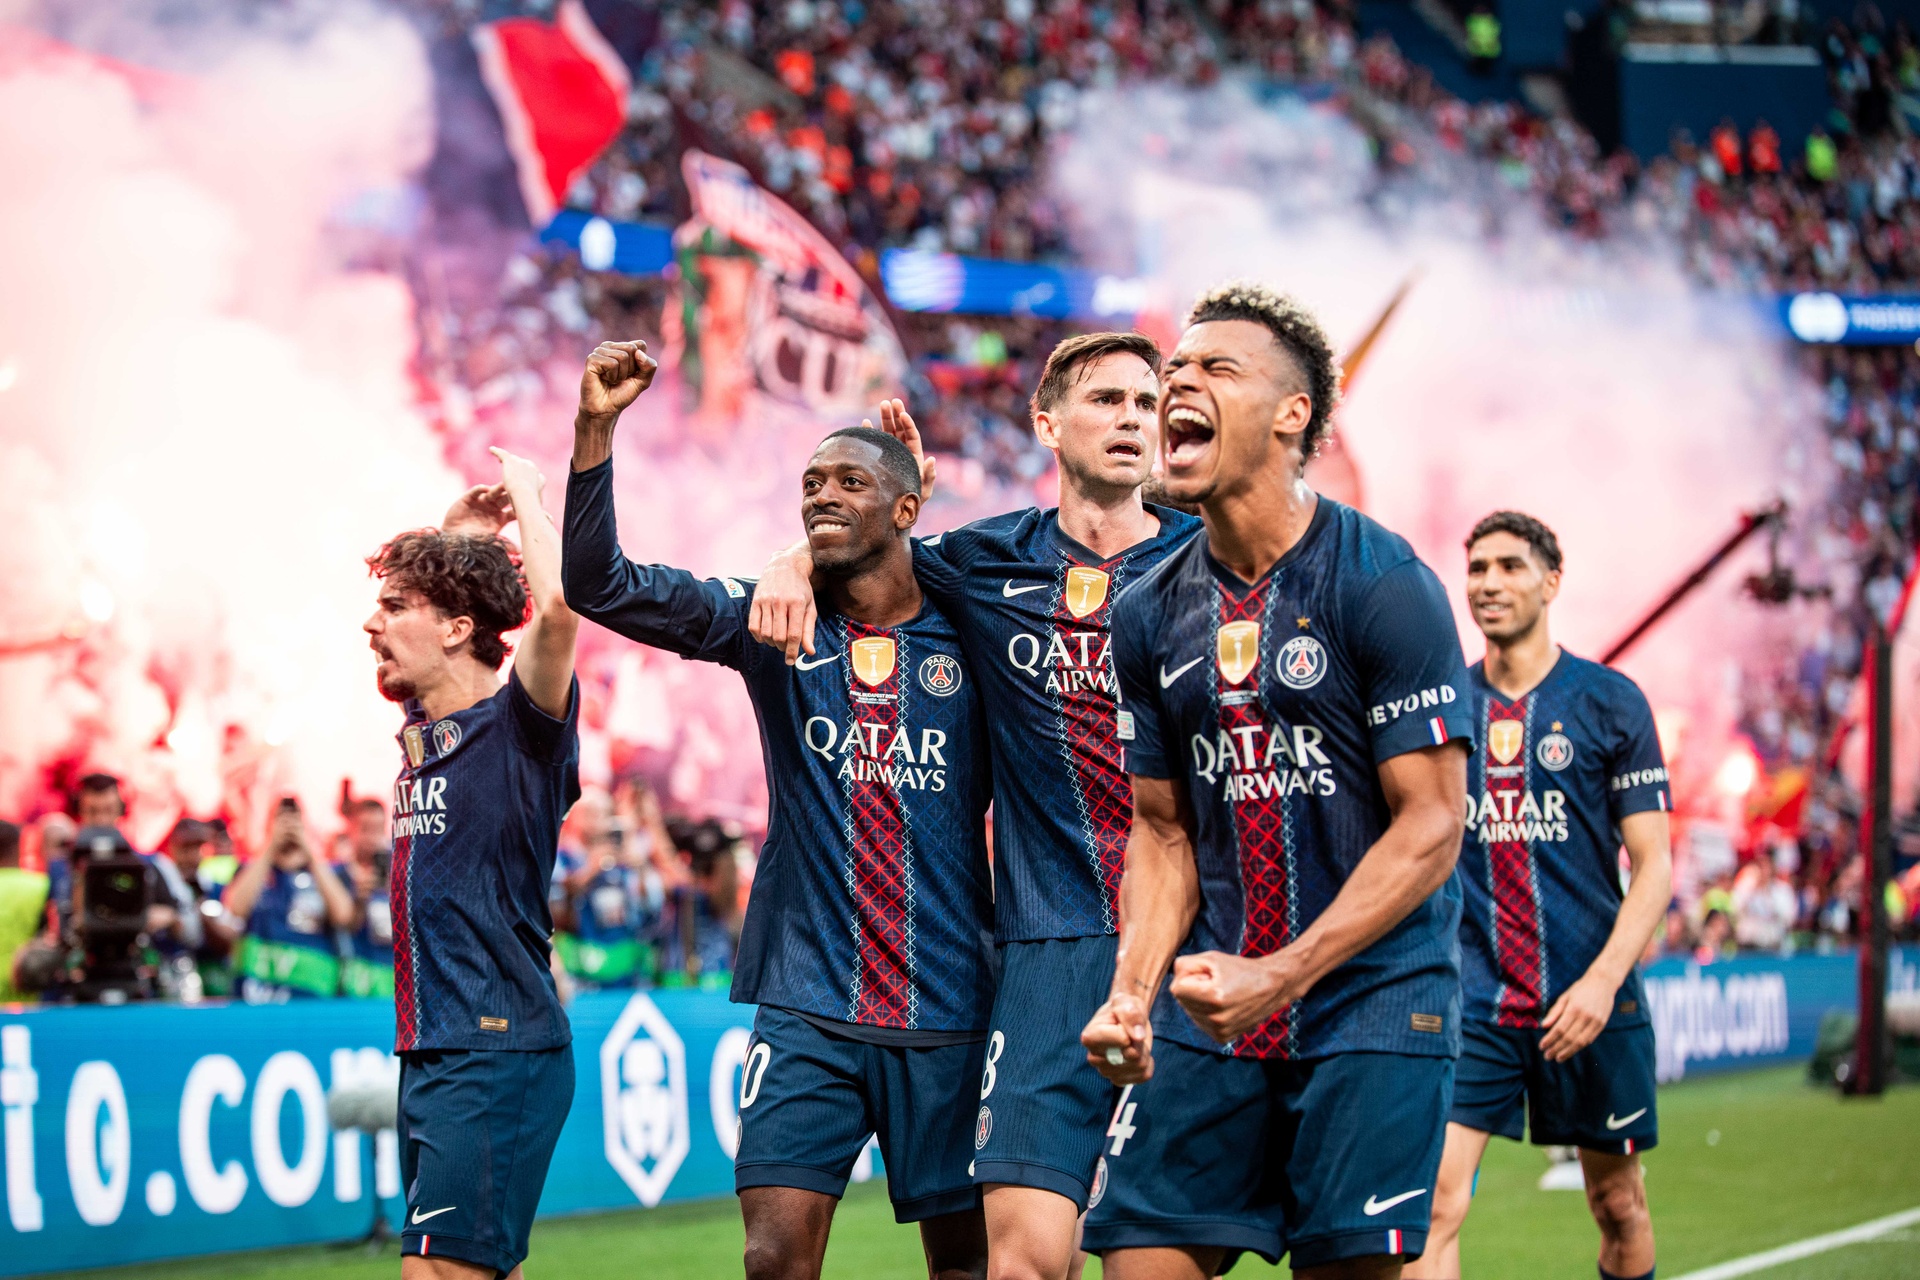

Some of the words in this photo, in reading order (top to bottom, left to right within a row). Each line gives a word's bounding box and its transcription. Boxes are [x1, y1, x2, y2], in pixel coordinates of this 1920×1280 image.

[927, 656, 956, 669] PARIS
[805, 715, 947, 766] QATAR
[1191, 724, 1332, 785] QATAR
[837, 758, 946, 792] AIRWAYS
[1223, 768, 1337, 802] AIRWAYS
[1477, 821, 1569, 844] AIRWAYS
[980, 1030, 1005, 1100] 8
[1106, 1083, 1138, 1156] 4
